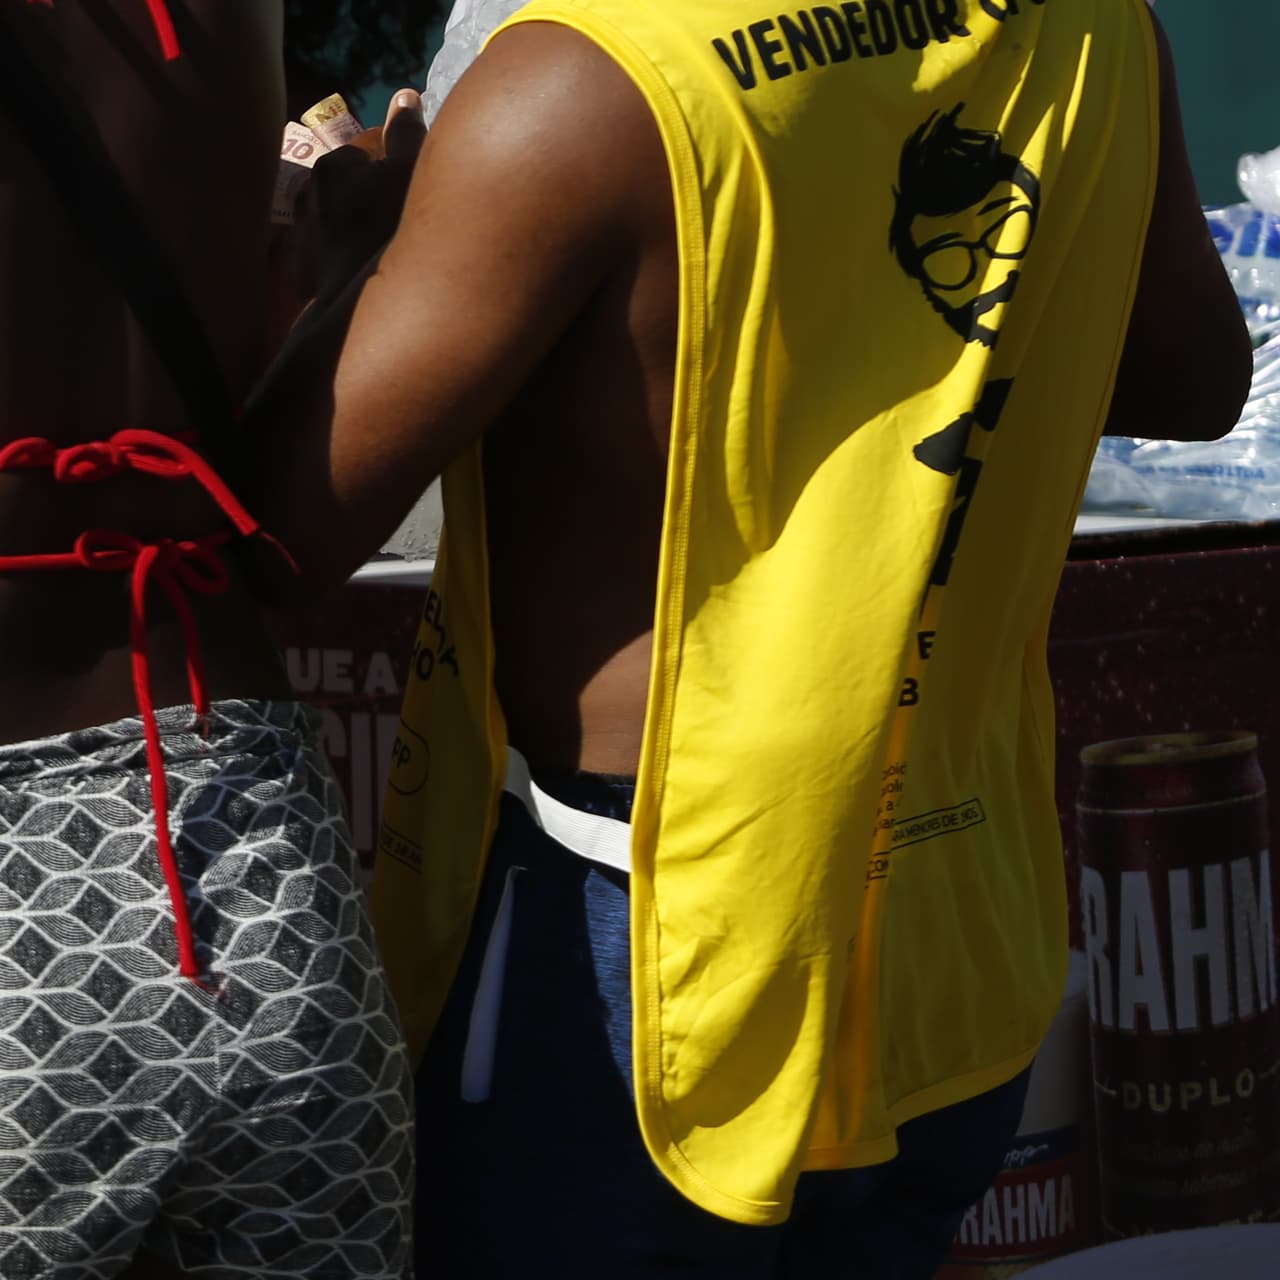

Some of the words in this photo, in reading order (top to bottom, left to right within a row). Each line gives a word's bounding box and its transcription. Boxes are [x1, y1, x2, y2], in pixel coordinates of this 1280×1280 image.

[281, 138, 315, 160] 10
[362, 651, 401, 696] A
[1120, 1066, 1256, 1113] DUPLO
